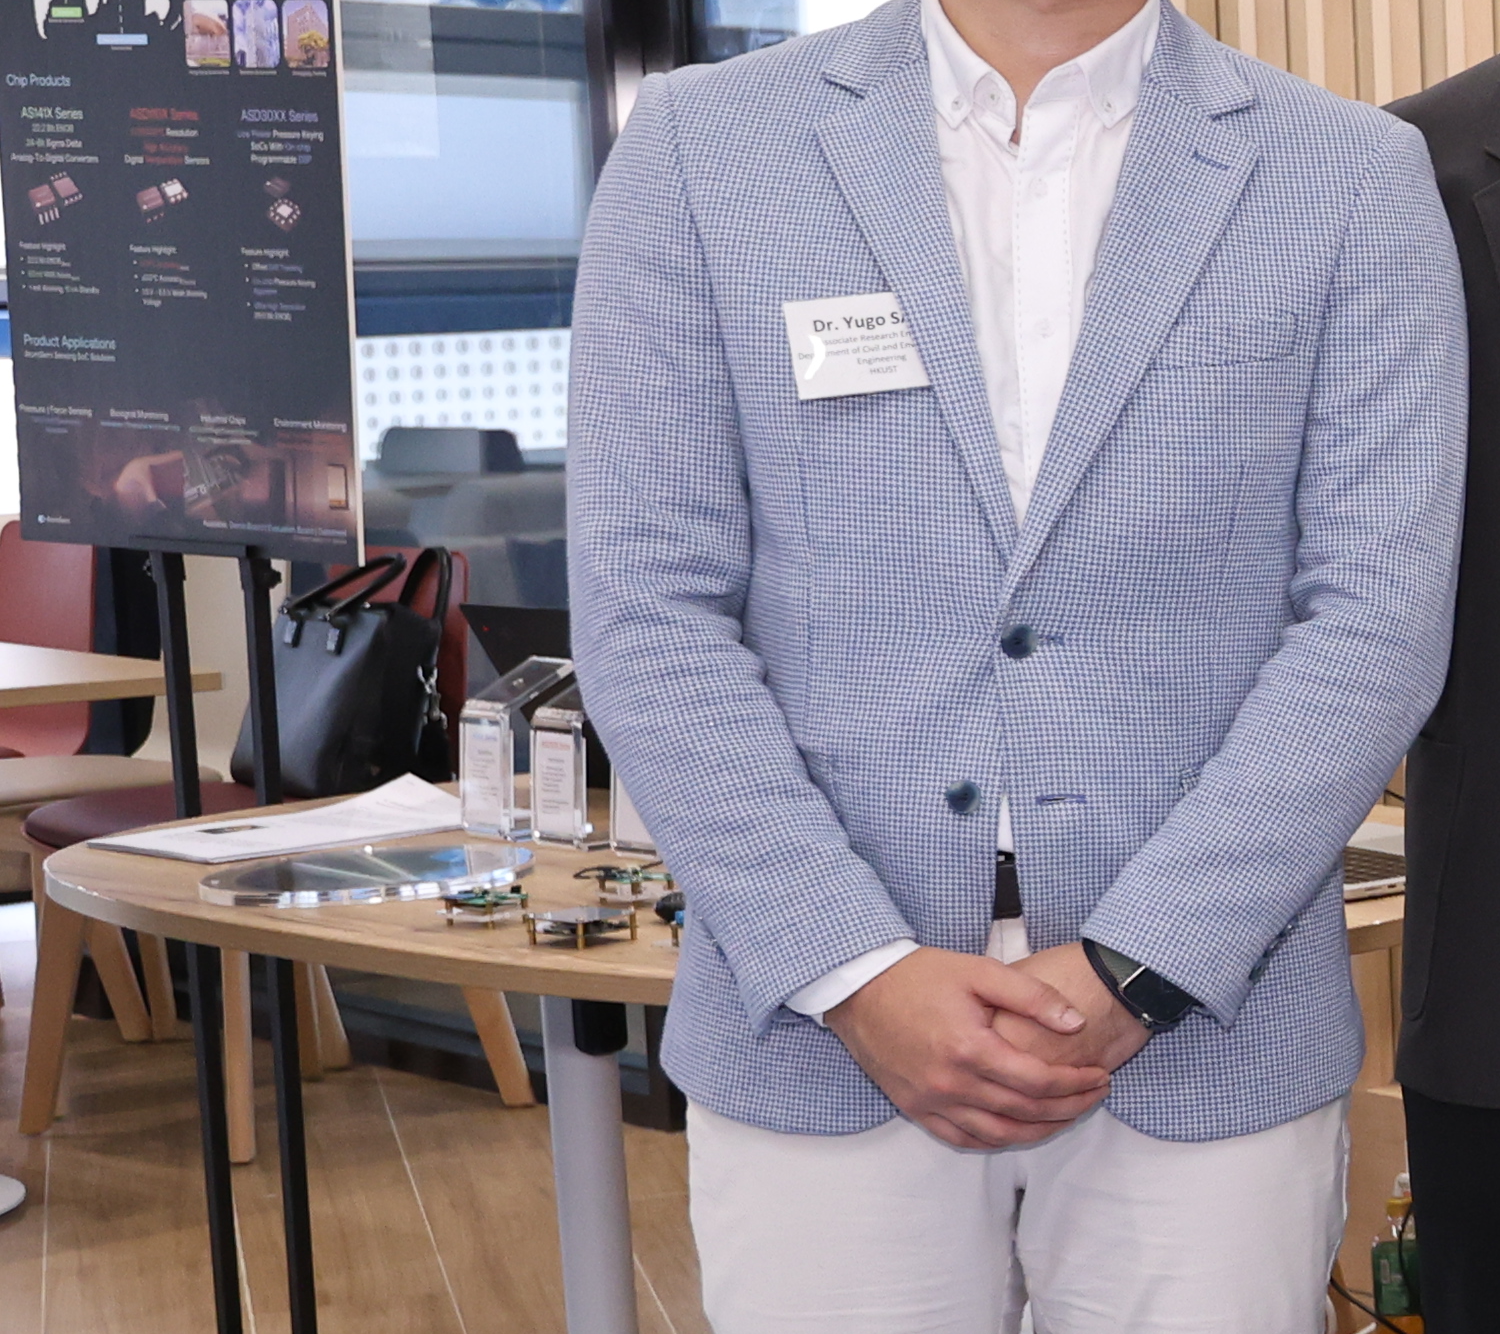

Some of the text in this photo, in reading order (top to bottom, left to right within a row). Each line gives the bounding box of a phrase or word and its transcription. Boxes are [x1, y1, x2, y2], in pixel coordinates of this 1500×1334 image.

[6, 74, 71, 87] Chip Products
[55, 108, 83, 120] Series
[289, 111, 318, 122] Series
[813, 320, 838, 332] Dr.
[844, 315, 886, 330] Yugo
[24, 334, 116, 350] Product Applications
